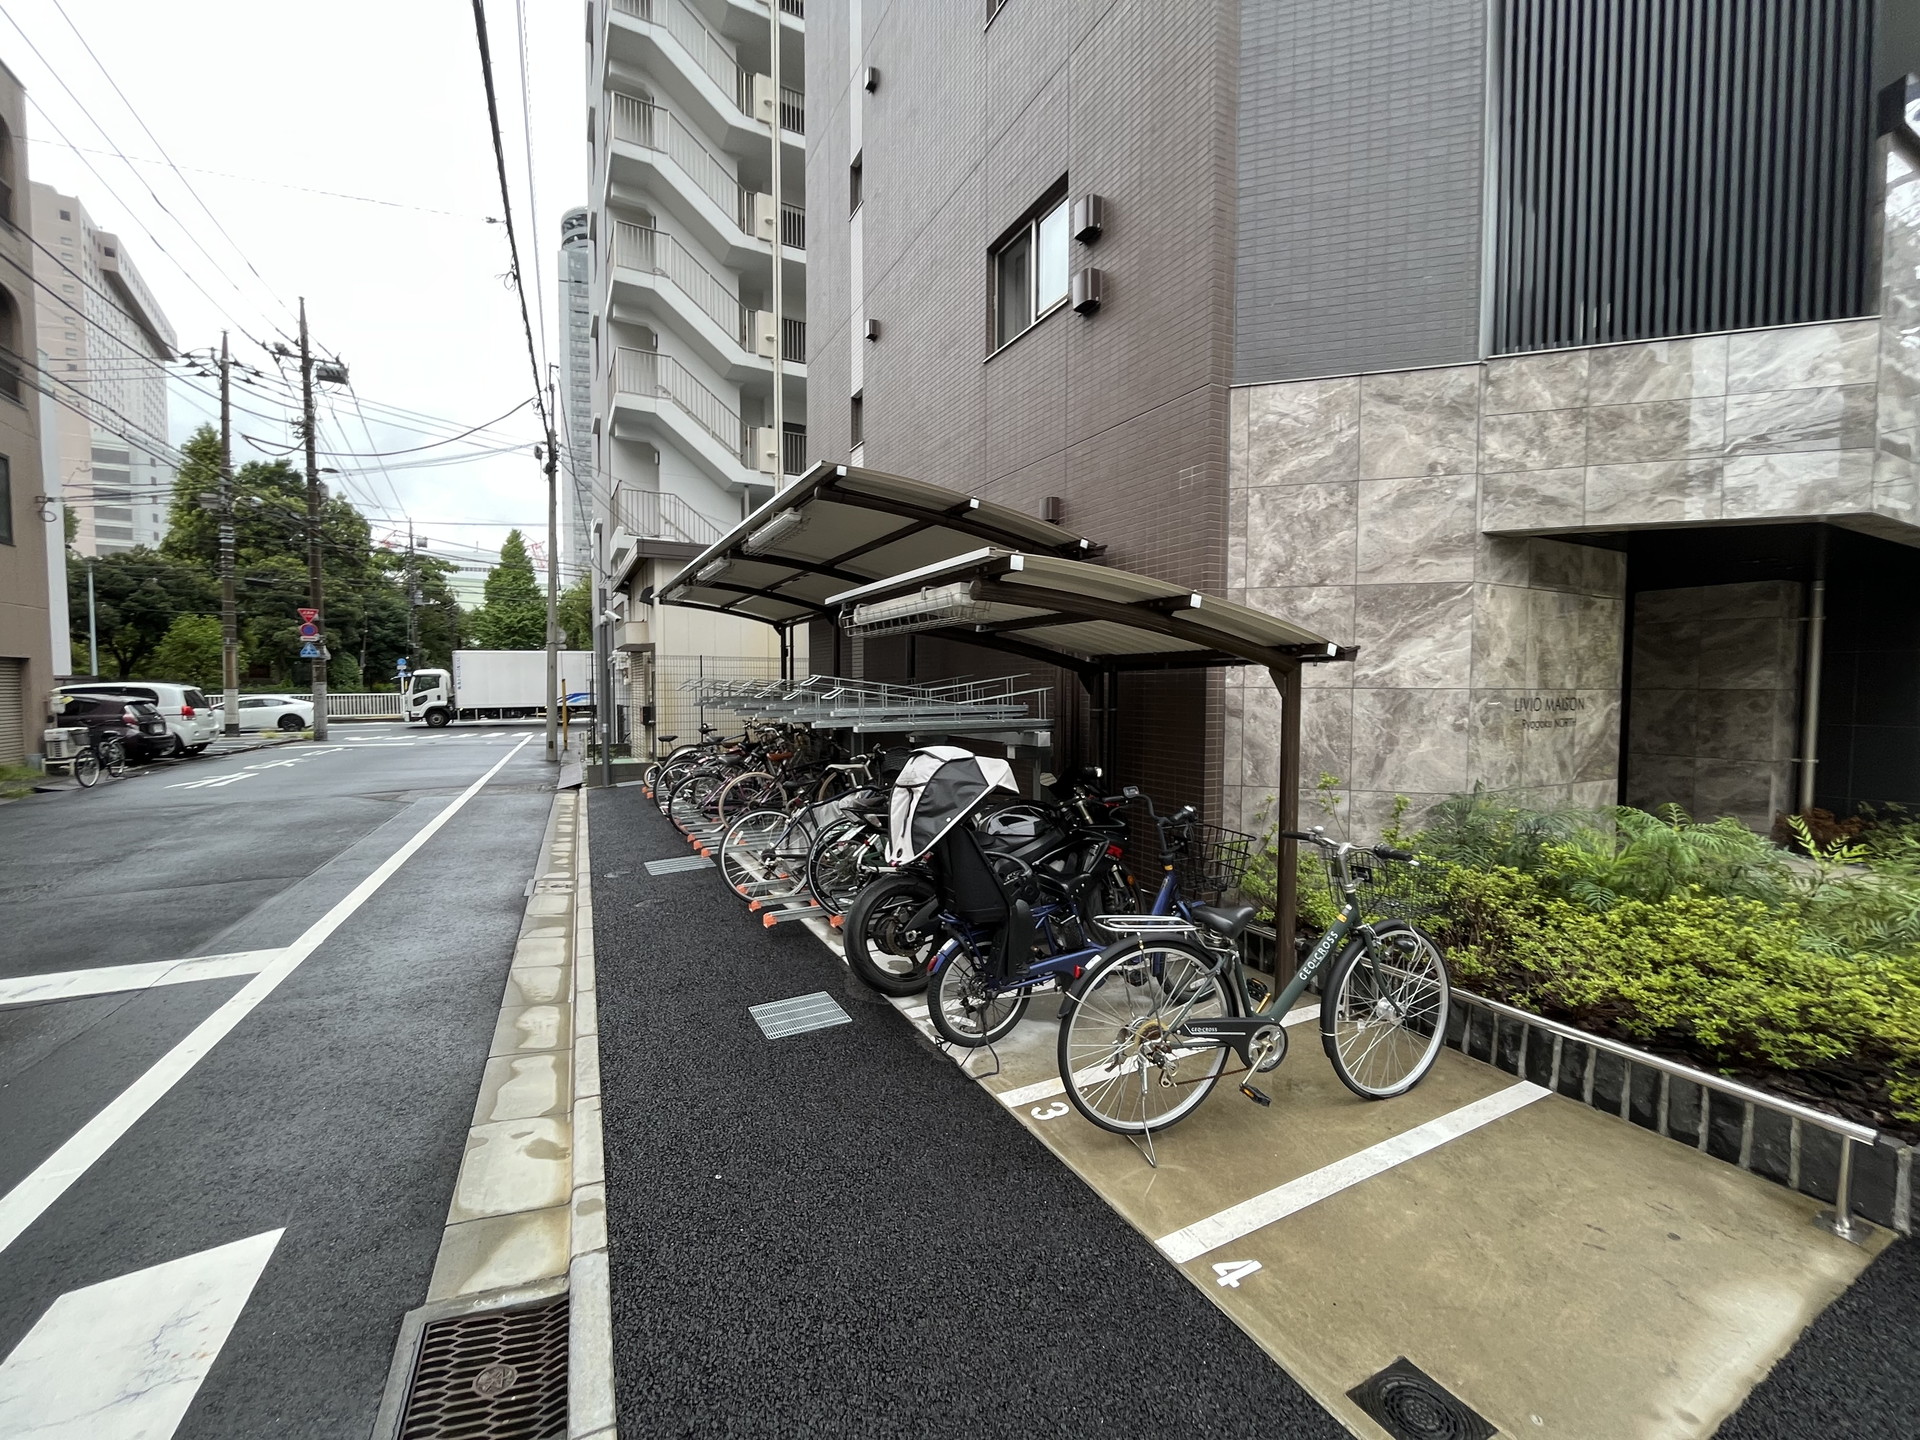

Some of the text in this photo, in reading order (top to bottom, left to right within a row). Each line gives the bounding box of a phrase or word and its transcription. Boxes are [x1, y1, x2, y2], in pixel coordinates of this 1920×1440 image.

[1514, 697, 1585, 712] LIVIO MAISON
[1030, 1101, 1070, 1120] 3
[1211, 1259, 1263, 1288] 4
